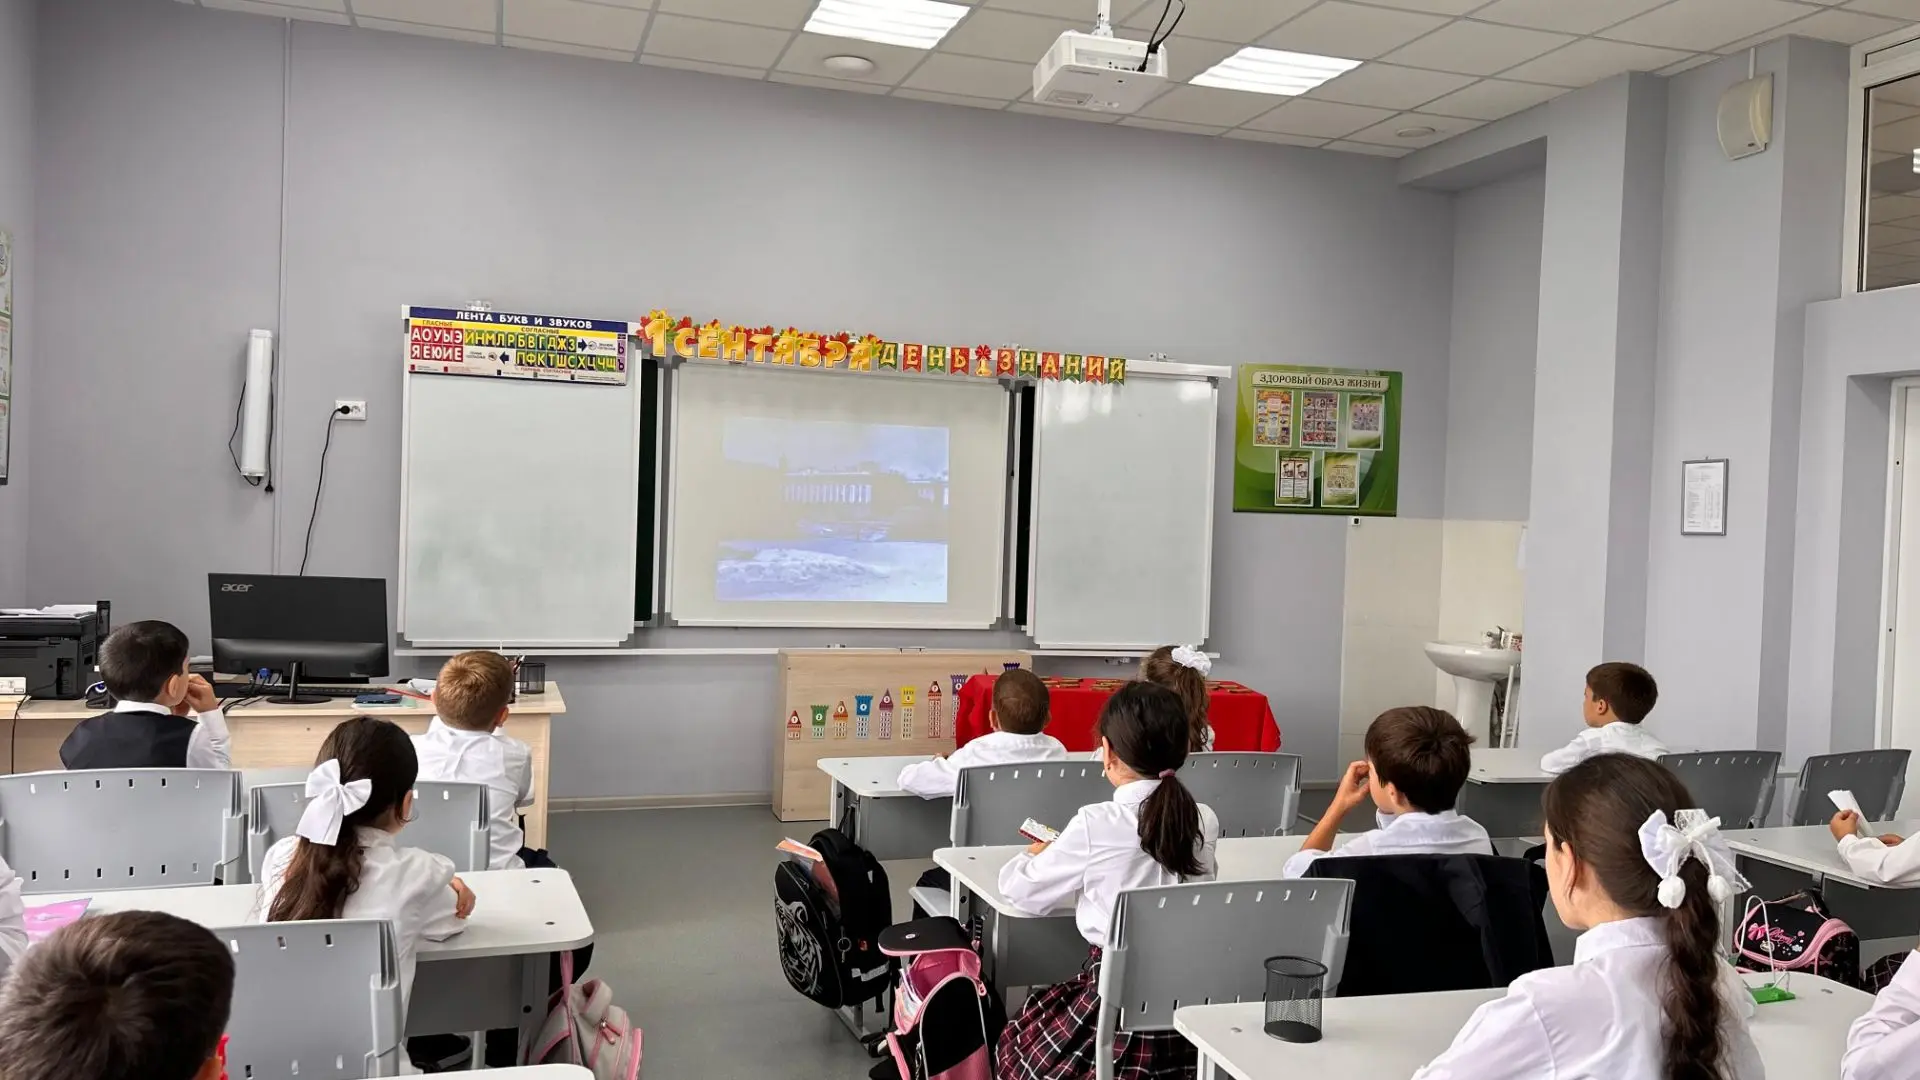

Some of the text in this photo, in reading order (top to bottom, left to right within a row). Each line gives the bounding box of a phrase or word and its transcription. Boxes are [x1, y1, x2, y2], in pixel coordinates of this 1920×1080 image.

[455, 311, 592, 329] ЛЕНТА БУКВ И ЗВУКОВ
[521, 327, 560, 335] СОГЛАСНЫЕ
[644, 317, 873, 373] 1 СЕНТЯБРЯ
[879, 343, 1125, 380] ДЕНЬ ЗНАНИЙ
[1259, 374, 1382, 388] ЗДОРОВЫЙ ОБРАЗ ЖИЗНИ
[221, 583, 254, 593] acer
